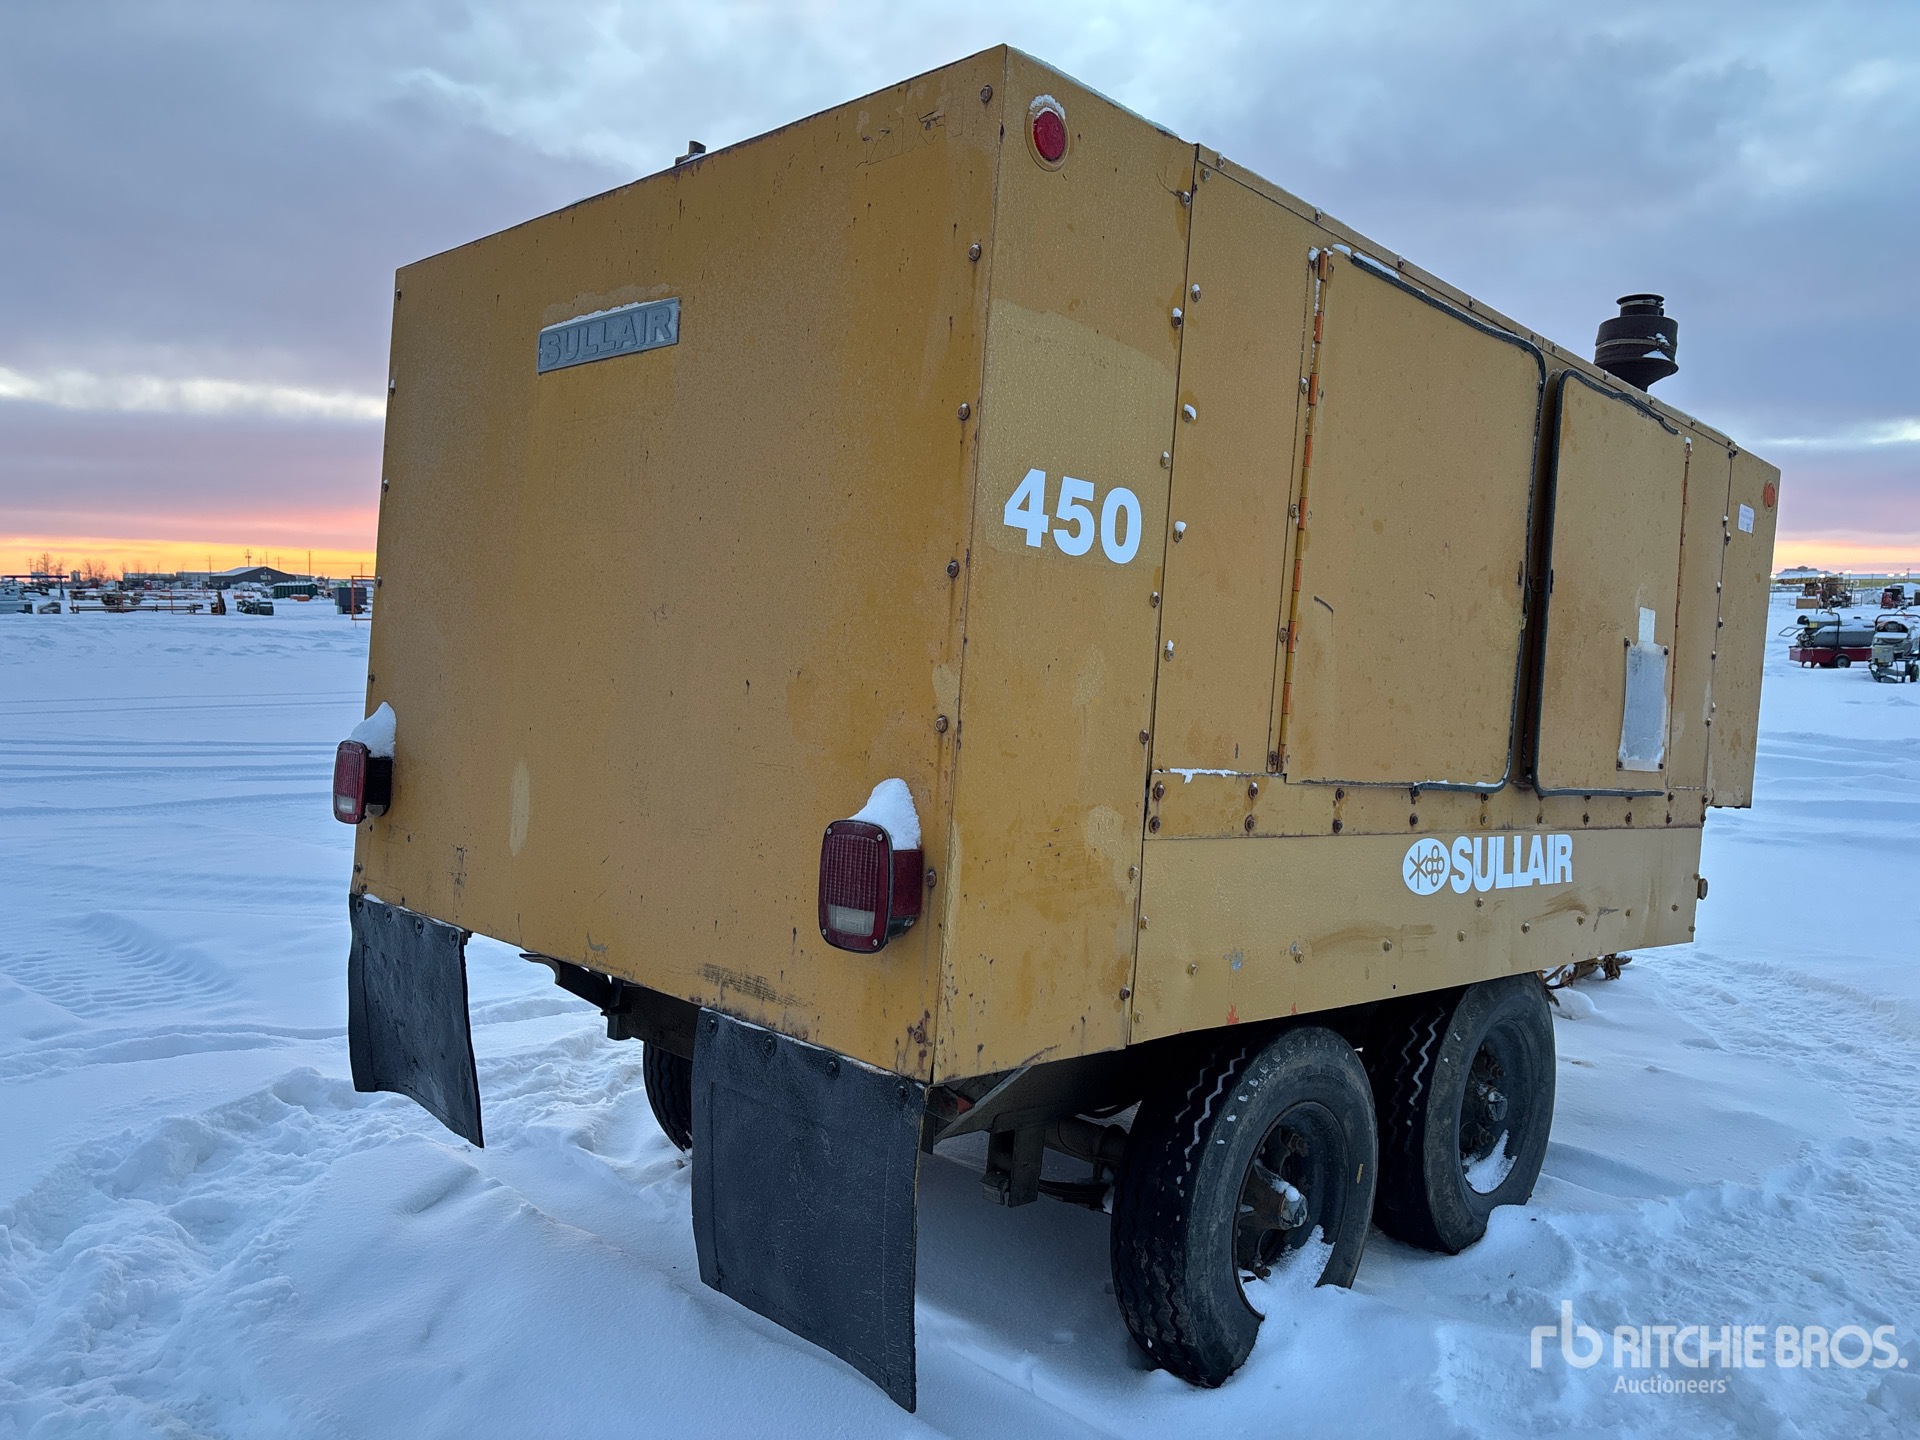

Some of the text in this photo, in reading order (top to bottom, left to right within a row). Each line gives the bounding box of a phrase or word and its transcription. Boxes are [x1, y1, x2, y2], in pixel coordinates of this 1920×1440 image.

[538, 306, 673, 366] SULLAIR
[1003, 468, 1142, 565] 450
[1450, 833, 1573, 895] SULLAIR
